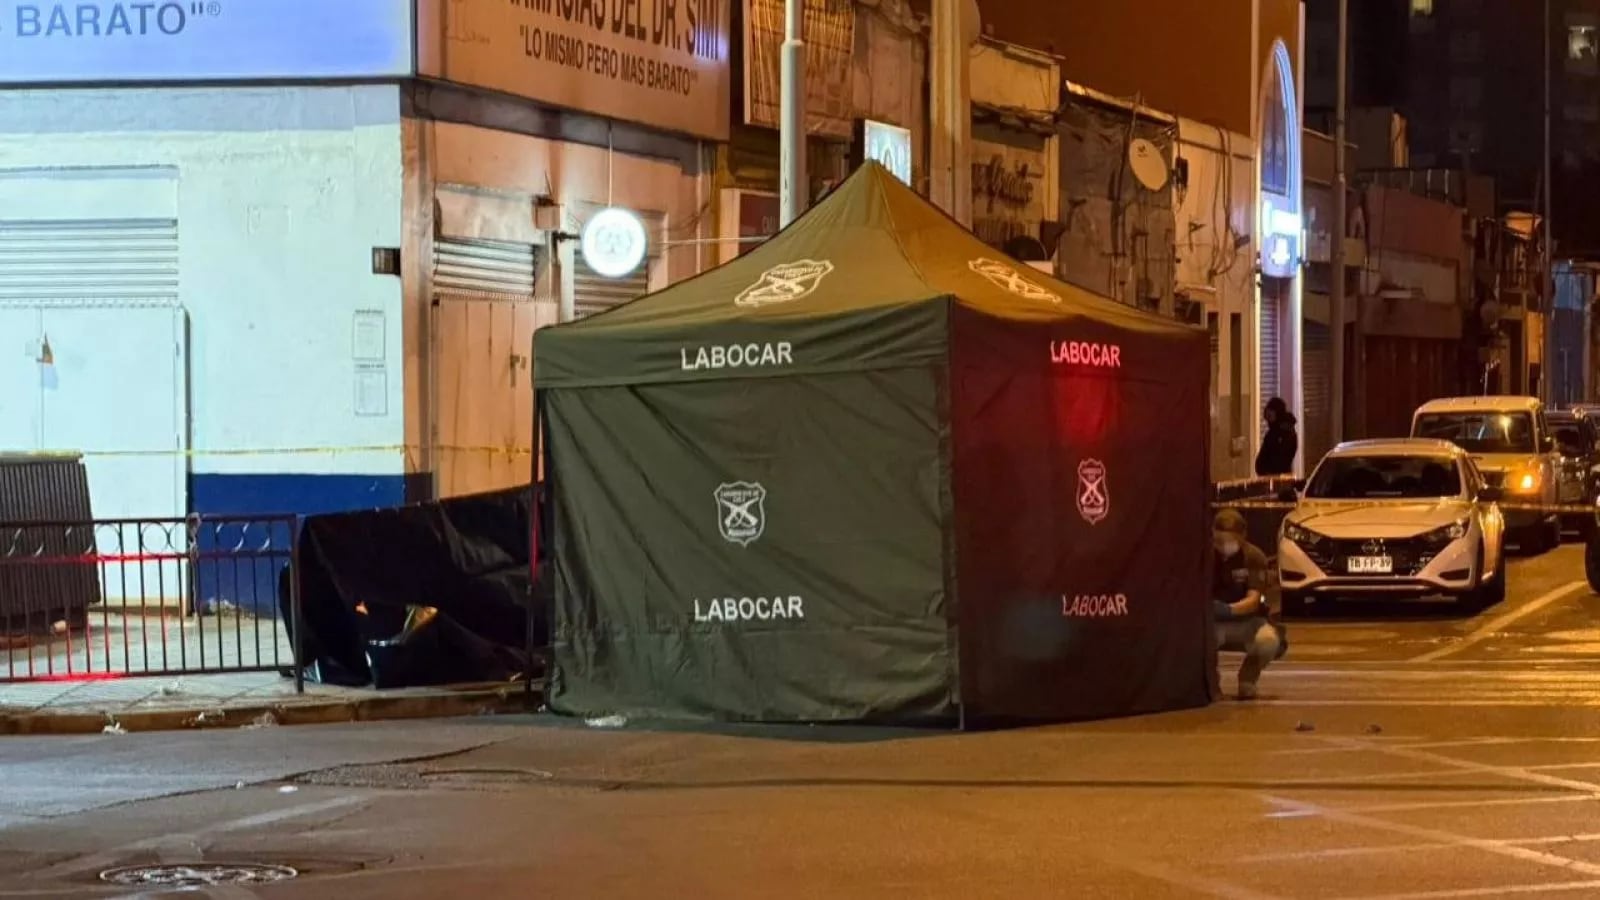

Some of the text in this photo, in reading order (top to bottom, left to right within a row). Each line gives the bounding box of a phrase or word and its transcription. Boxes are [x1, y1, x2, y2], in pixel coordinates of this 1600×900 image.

[652, 0, 681, 50] DR.
[685, 0, 719, 60] SIMI
[520, 24, 542, 59] "LO
[544, 31, 585, 69] MISMO
[586, 42, 618, 79] PERO
[621, 52, 645, 86] MAS
[681, 342, 793, 370] LABOCAR
[1050, 340, 1121, 367] LABOCAR
[694, 595, 805, 622] LABOCAR
[1062, 593, 1128, 617] LABOCAR
